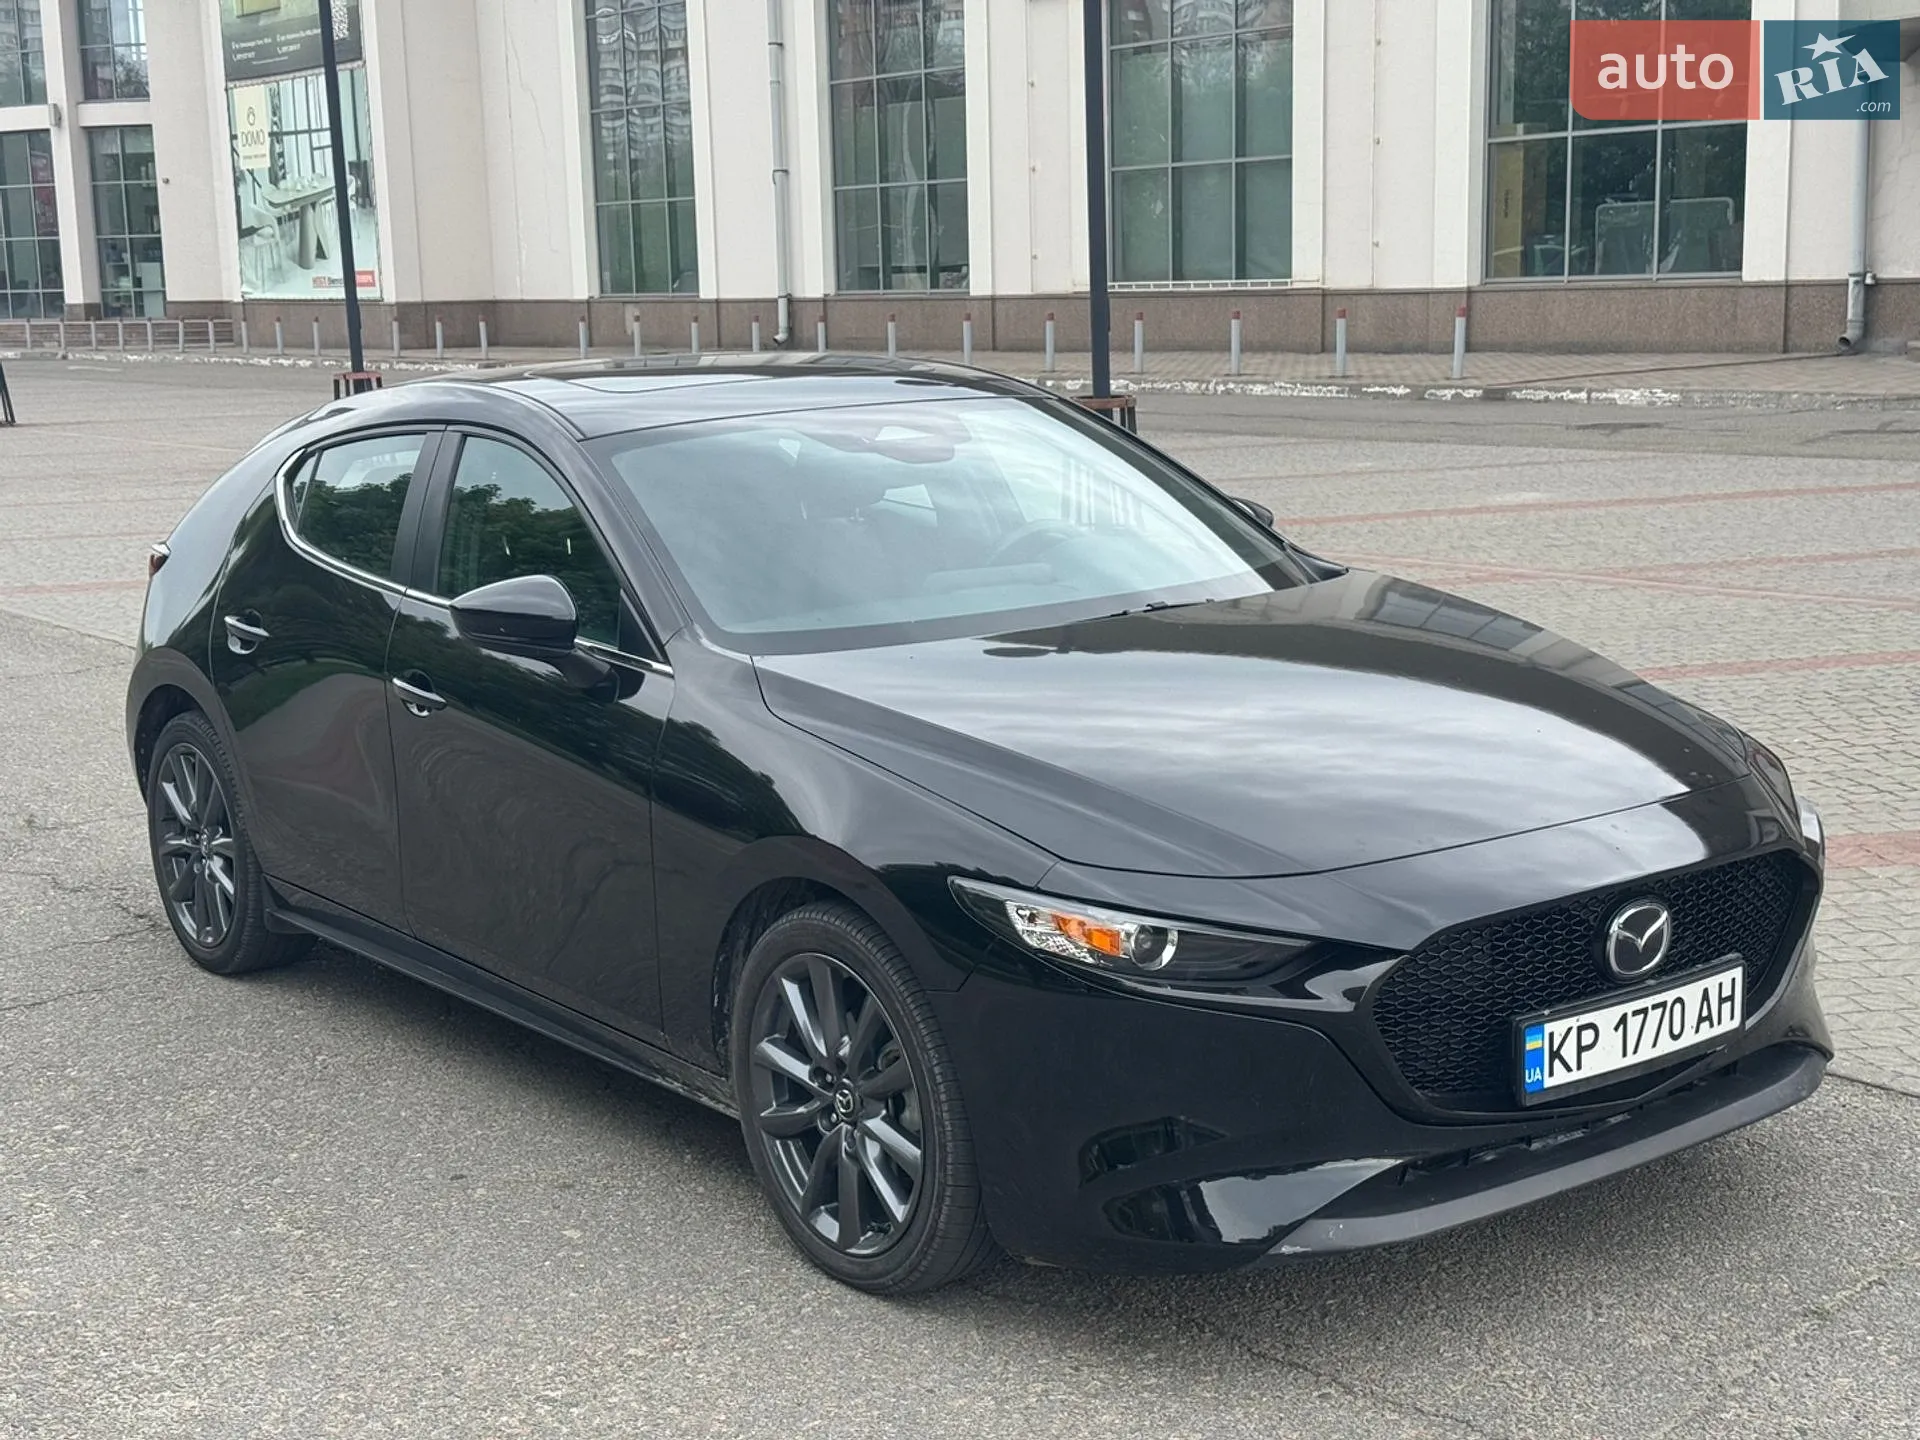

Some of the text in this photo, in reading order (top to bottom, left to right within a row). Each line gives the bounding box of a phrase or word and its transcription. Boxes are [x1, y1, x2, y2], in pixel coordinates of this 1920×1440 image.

[1548, 977, 1736, 1079] KP 1770 AH
[1525, 1067, 1542, 1083] UA
